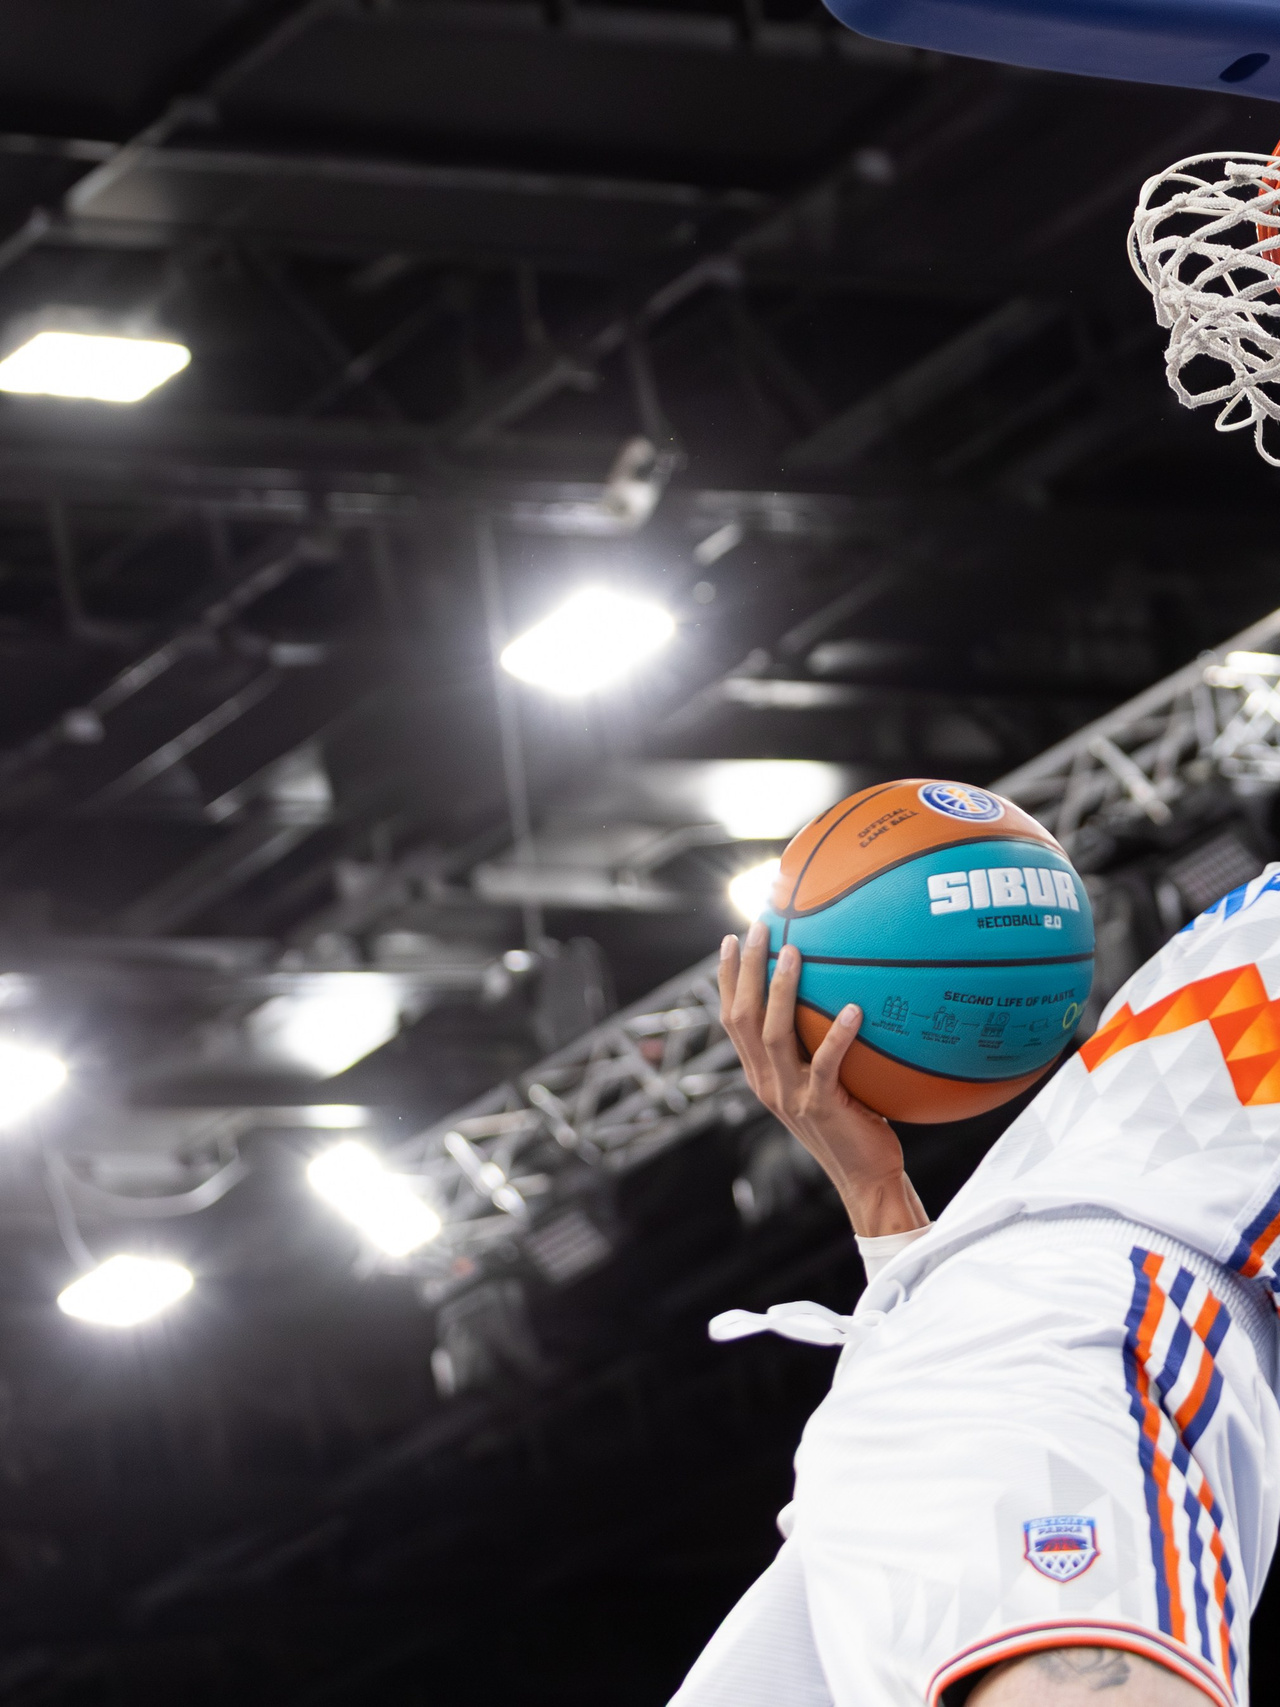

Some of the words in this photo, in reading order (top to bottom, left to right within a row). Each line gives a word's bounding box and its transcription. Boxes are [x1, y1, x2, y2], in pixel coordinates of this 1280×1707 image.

[858, 808, 907, 838] OFFICIAL
[859, 826, 889, 848] GAME
[891, 810, 919, 826] BALL
[927, 867, 1080, 915] SIBUR
[977, 915, 1041, 928] #ECOBALL
[1044, 914, 1062, 929] 2.0
[944, 991, 993, 1006] SECOND
[997, 997, 1023, 1007] LIFE
[1025, 997, 1039, 1007] OF
